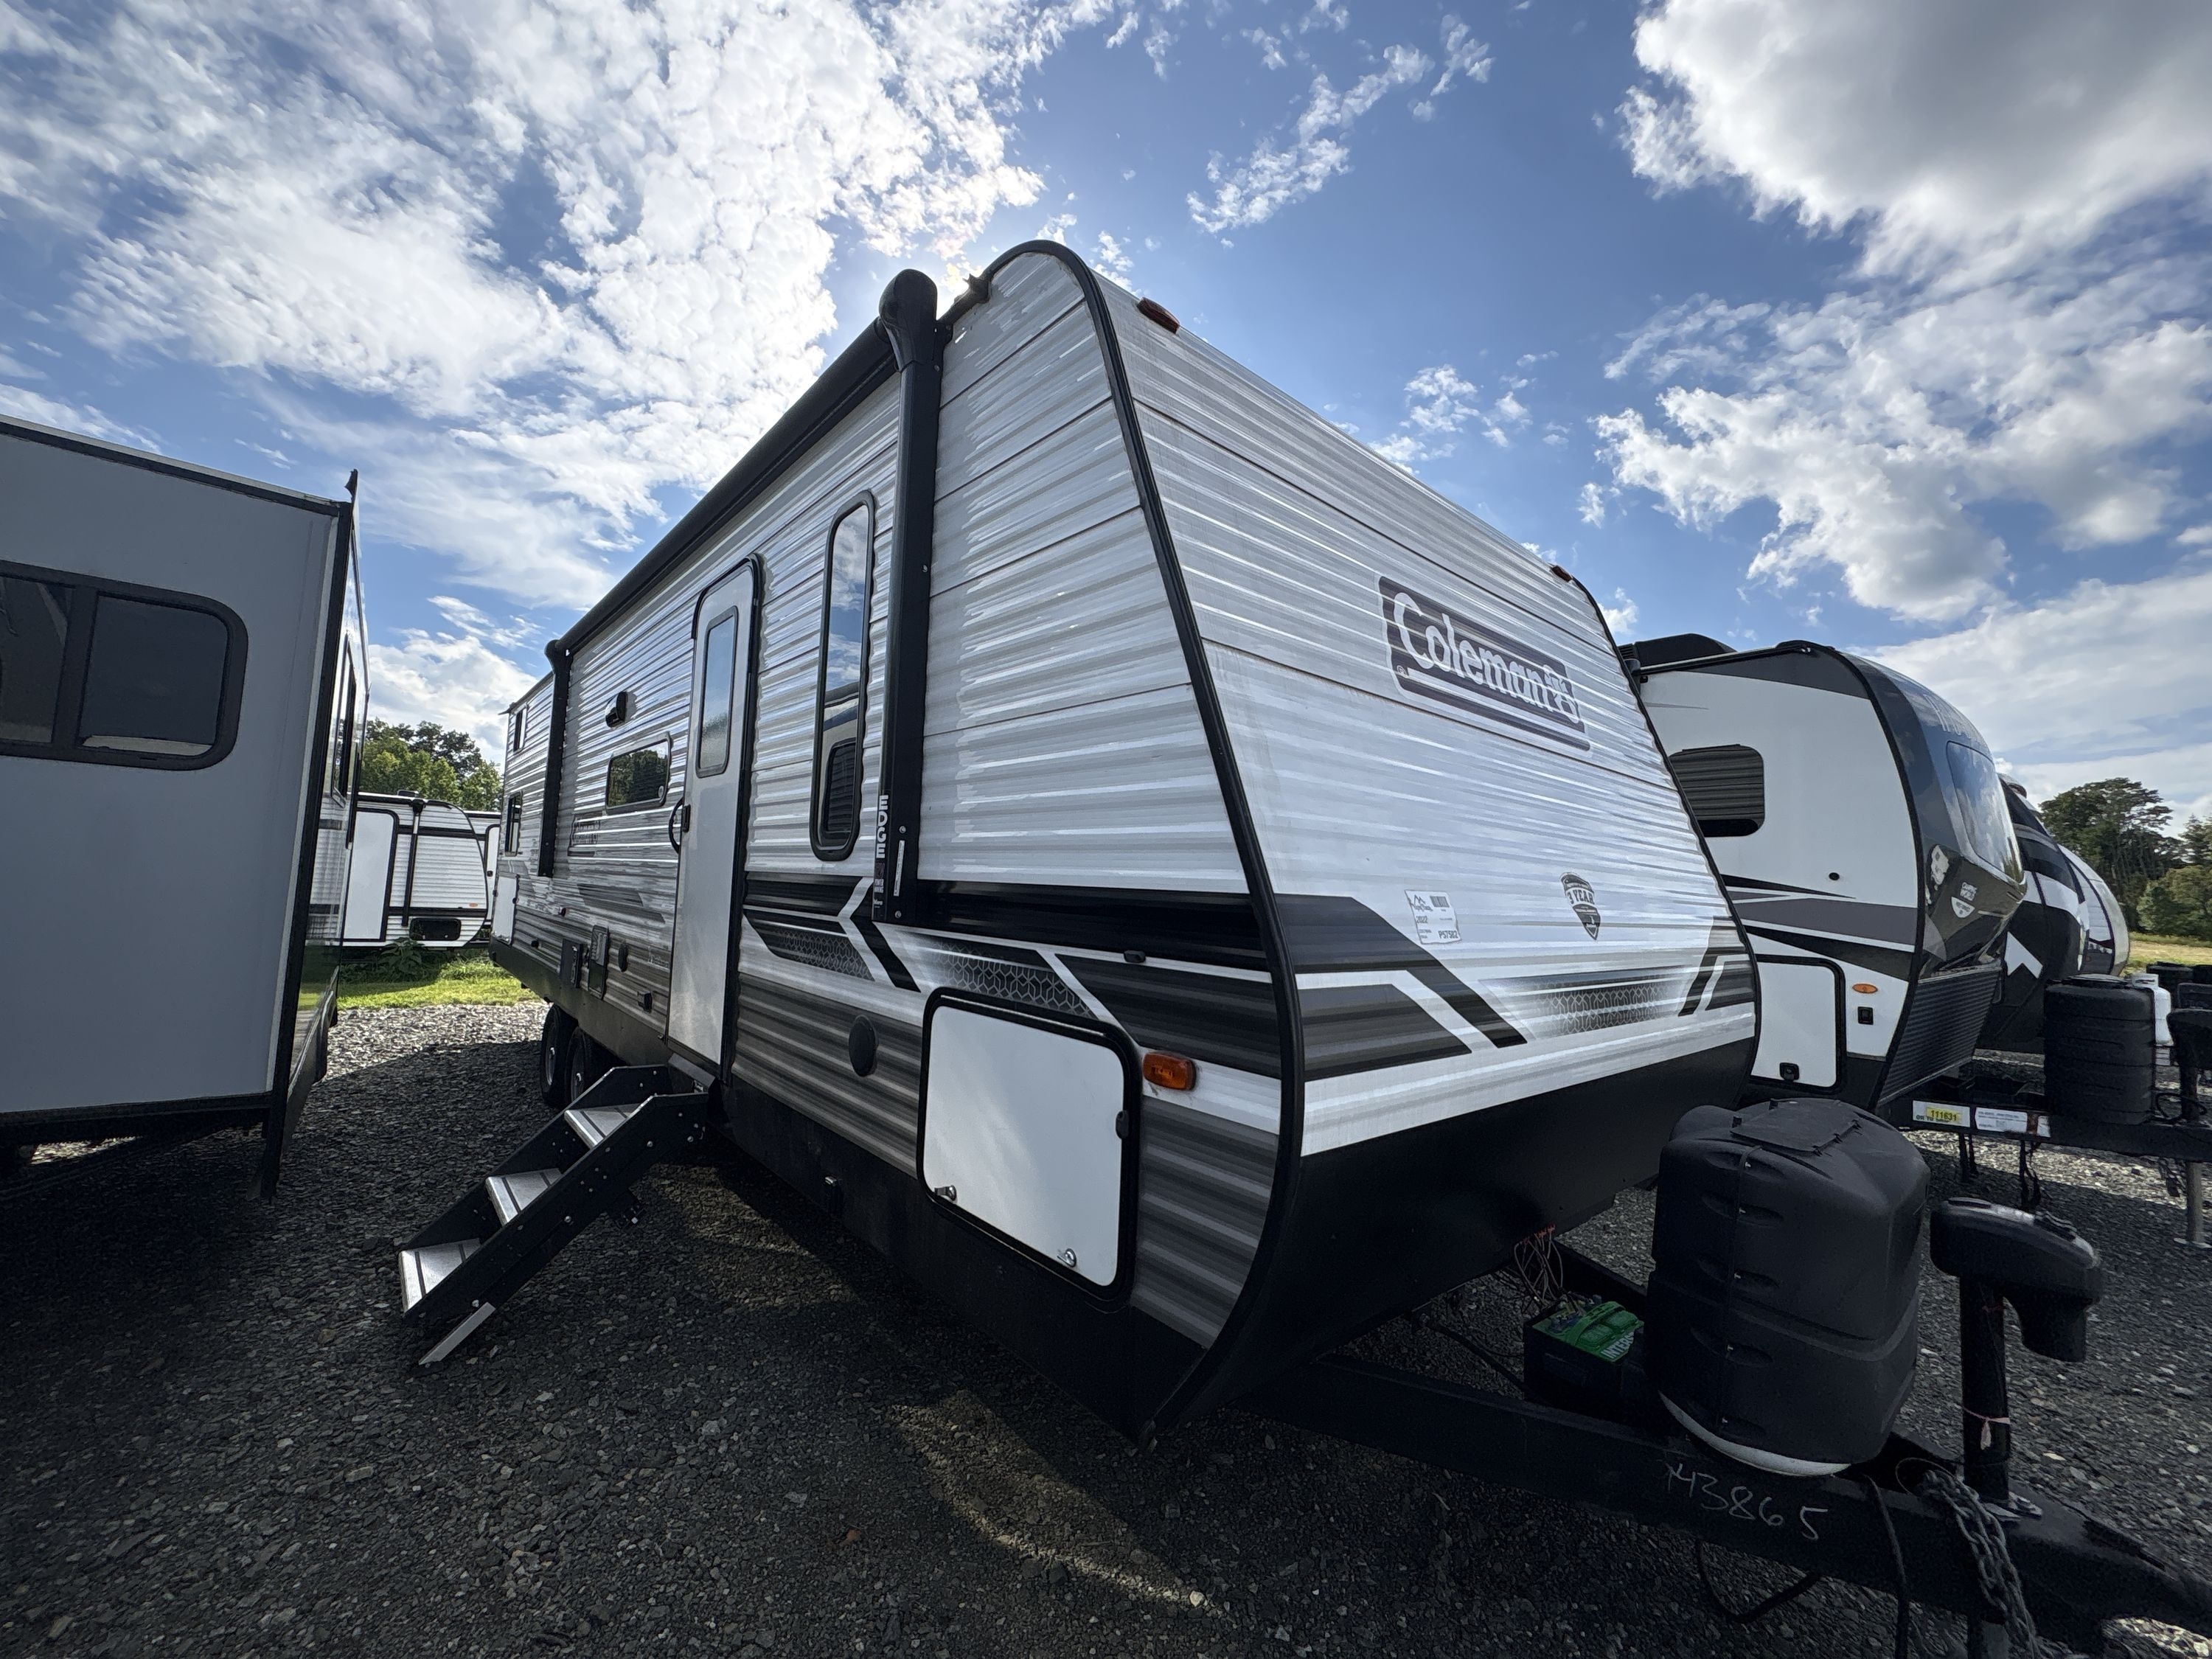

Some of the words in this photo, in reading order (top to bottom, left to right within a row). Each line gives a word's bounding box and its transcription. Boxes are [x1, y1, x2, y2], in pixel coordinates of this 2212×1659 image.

[1394, 592, 1554, 712] Coleman
[875, 795, 888, 859] EDGE
[1568, 891, 1575, 905] 3
[1572, 888, 1595, 905] YEAR
